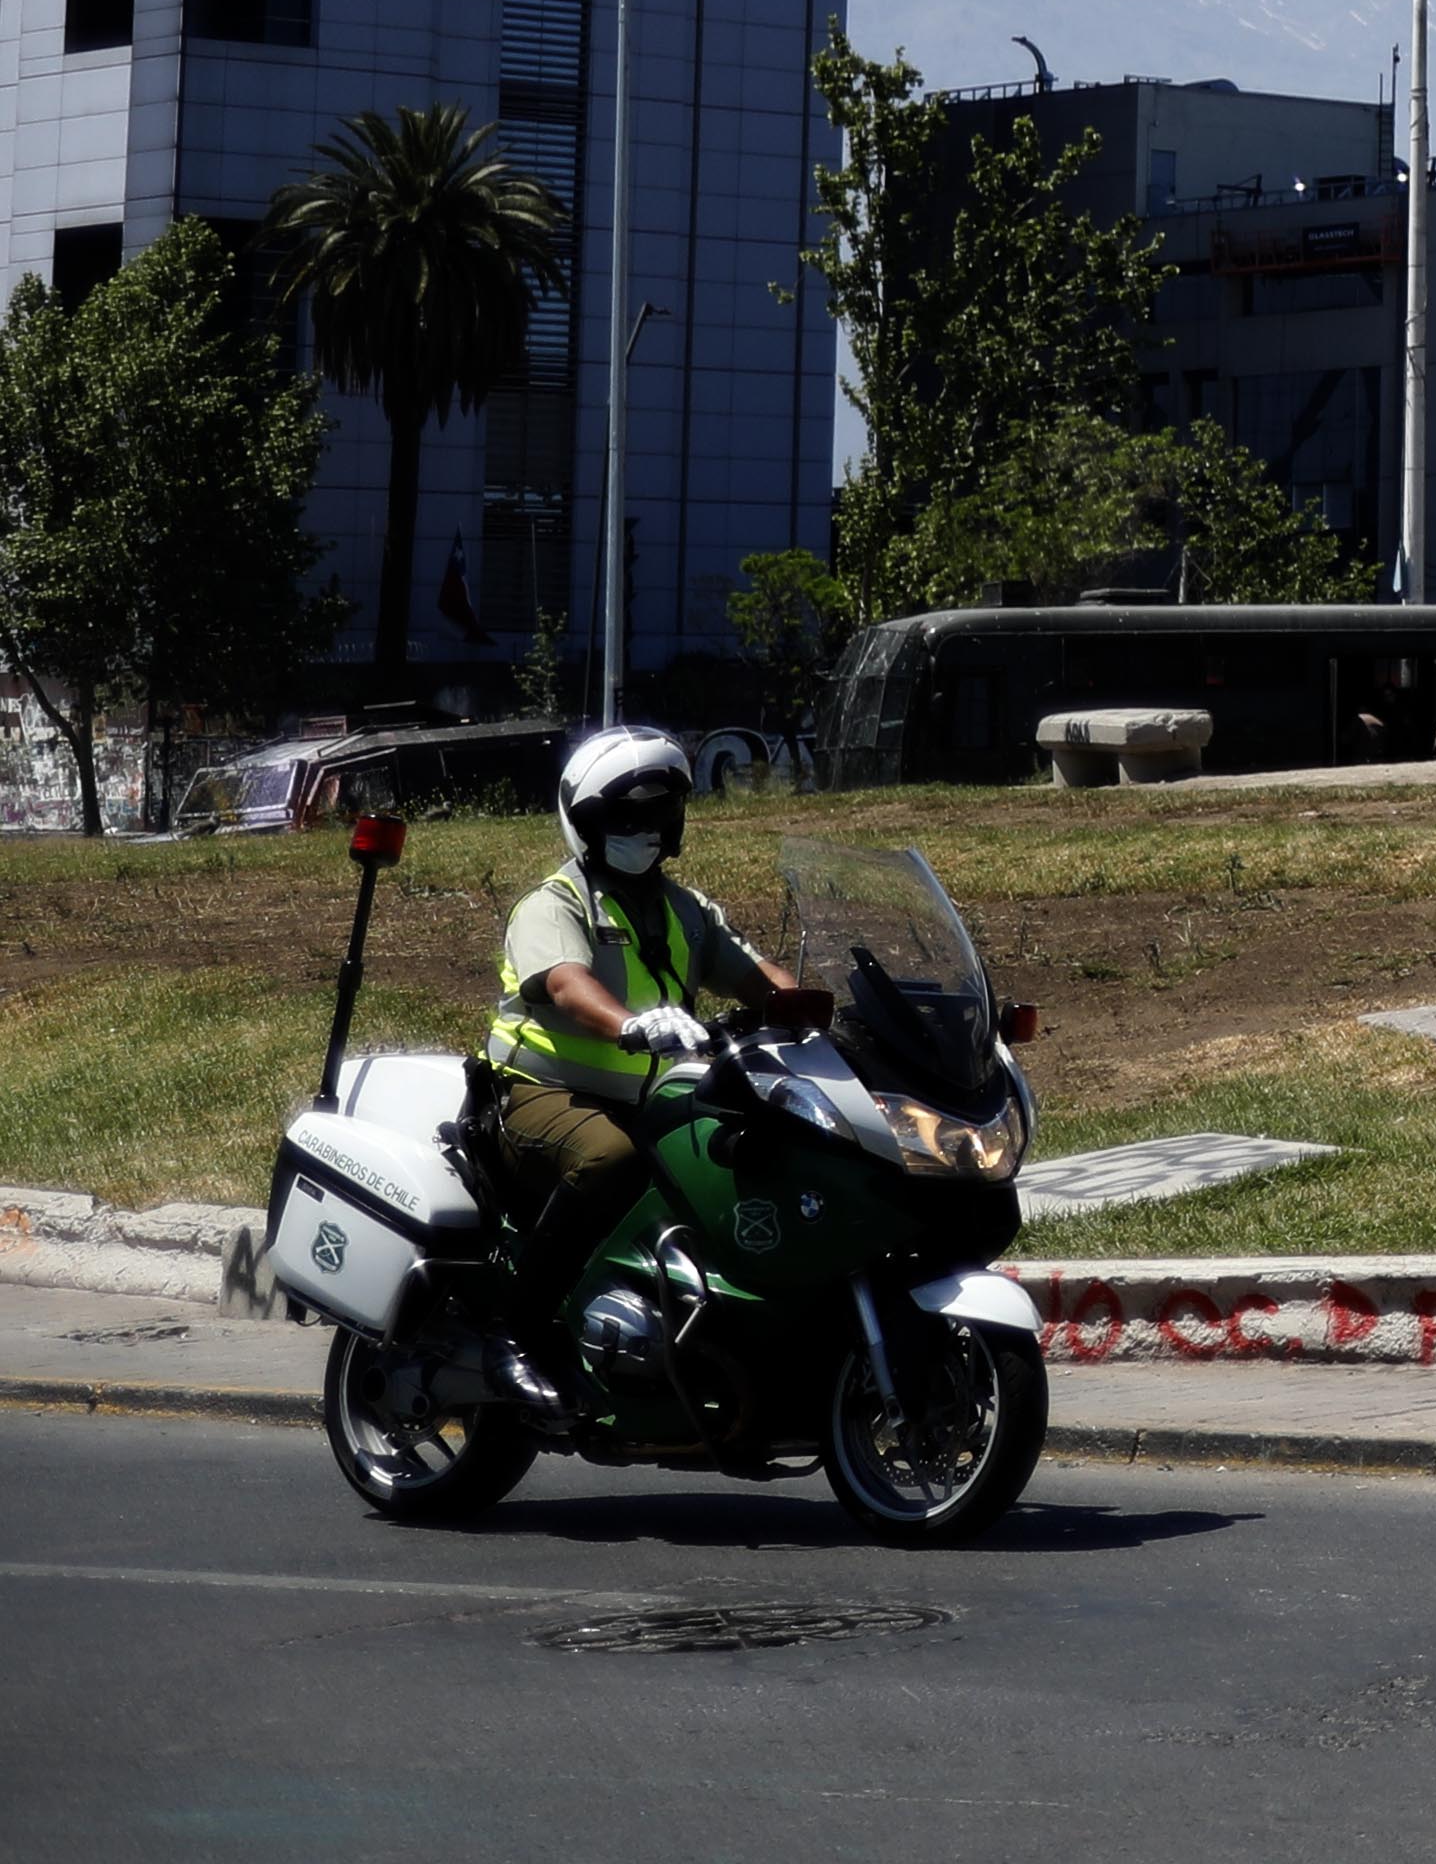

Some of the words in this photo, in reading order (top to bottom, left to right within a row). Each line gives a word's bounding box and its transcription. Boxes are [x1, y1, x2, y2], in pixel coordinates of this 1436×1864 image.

[297, 1129, 368, 1181] CARABINEROS
[366, 1171, 385, 1191] DE
[384, 1182, 421, 1212] CHILE
